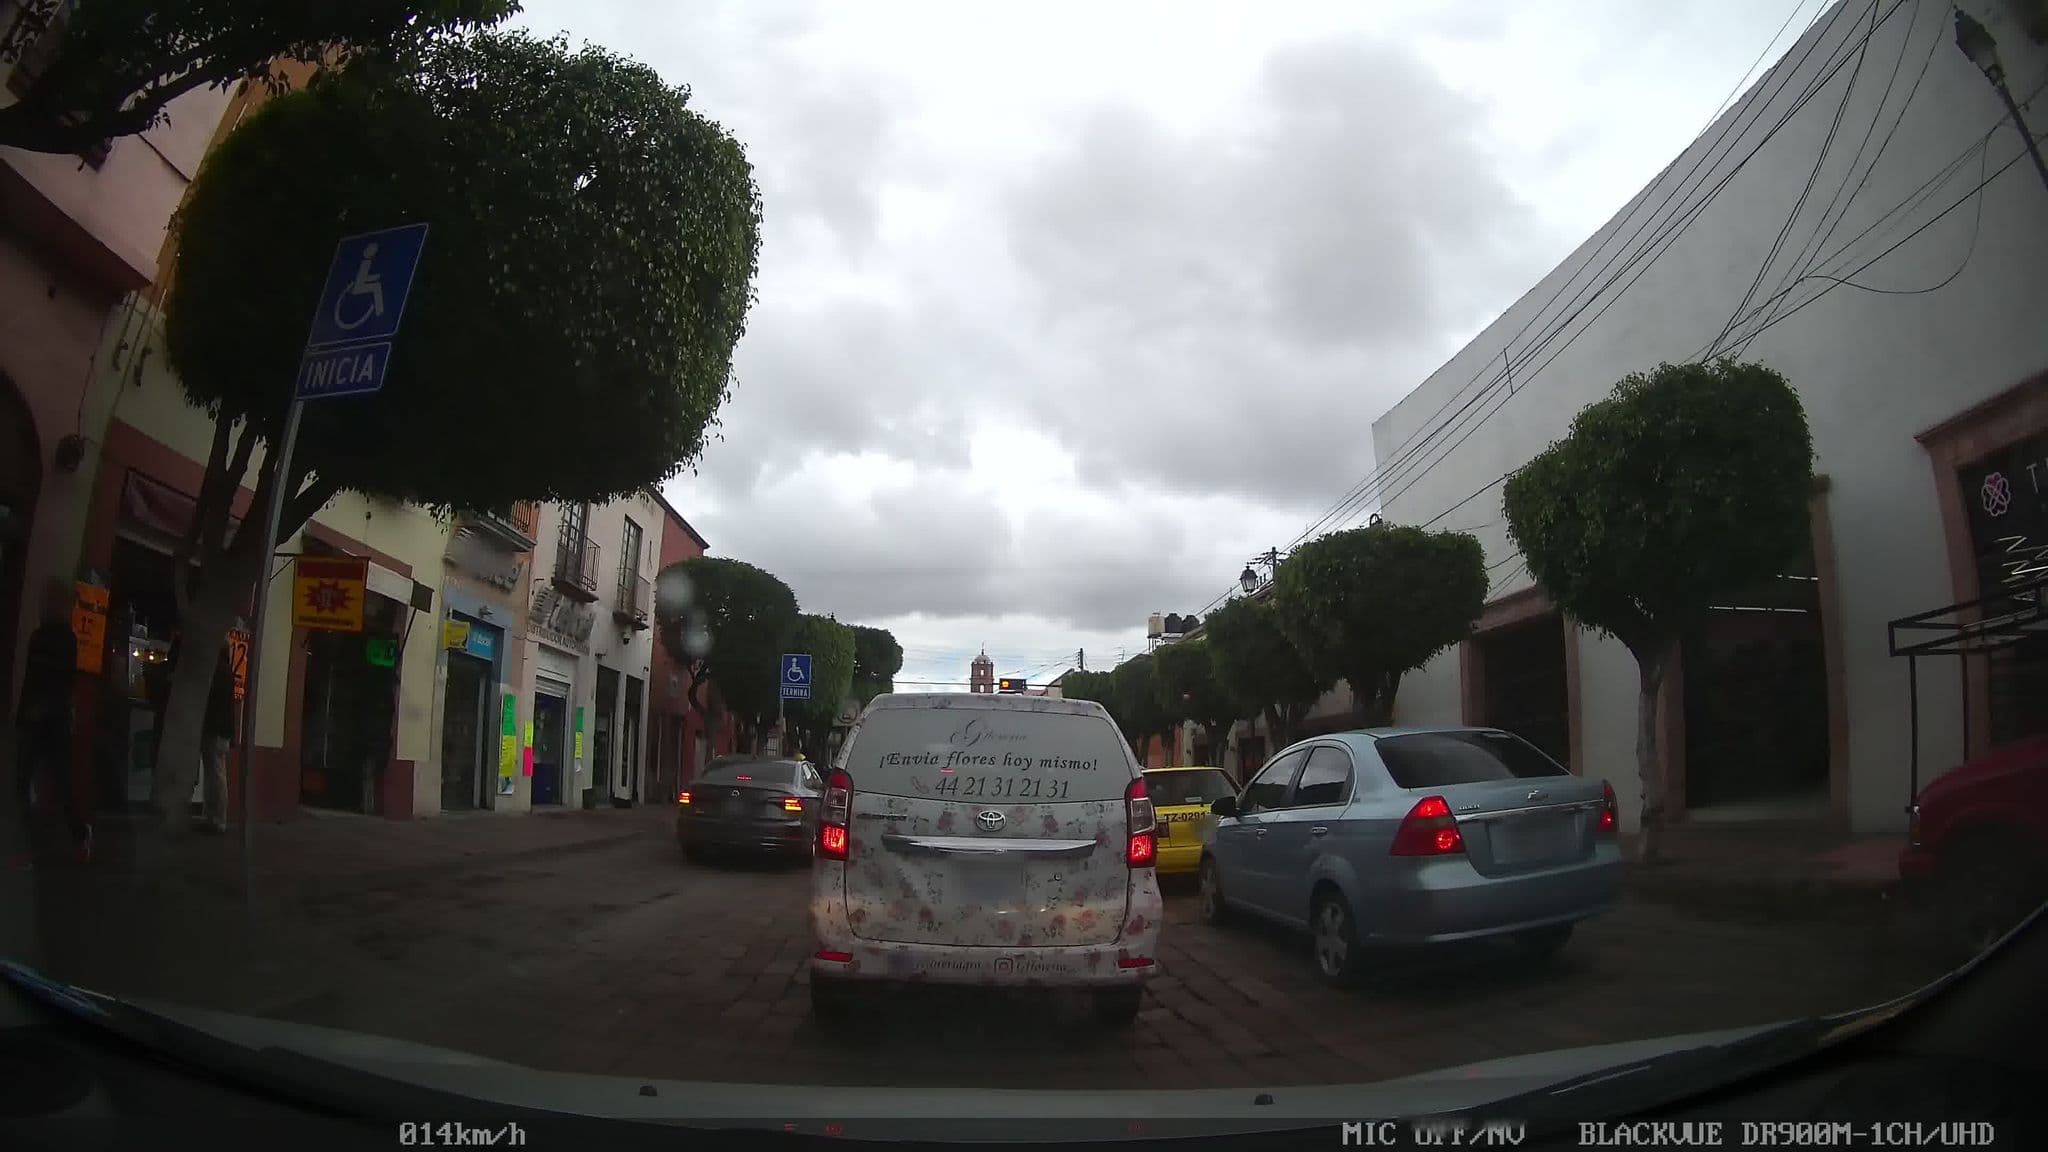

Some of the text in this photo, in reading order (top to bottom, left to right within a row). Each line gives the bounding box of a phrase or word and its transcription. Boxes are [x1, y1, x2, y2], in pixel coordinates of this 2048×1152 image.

[304, 353, 375, 389] INICIA
[782, 687, 808, 697] TERMINA
[941, 750, 996, 769] flores
[1002, 752, 1033, 770] hoy
[1039, 758, 1098, 770] mismo!
[935, 776, 1069, 798] 44 21 31 21 31
